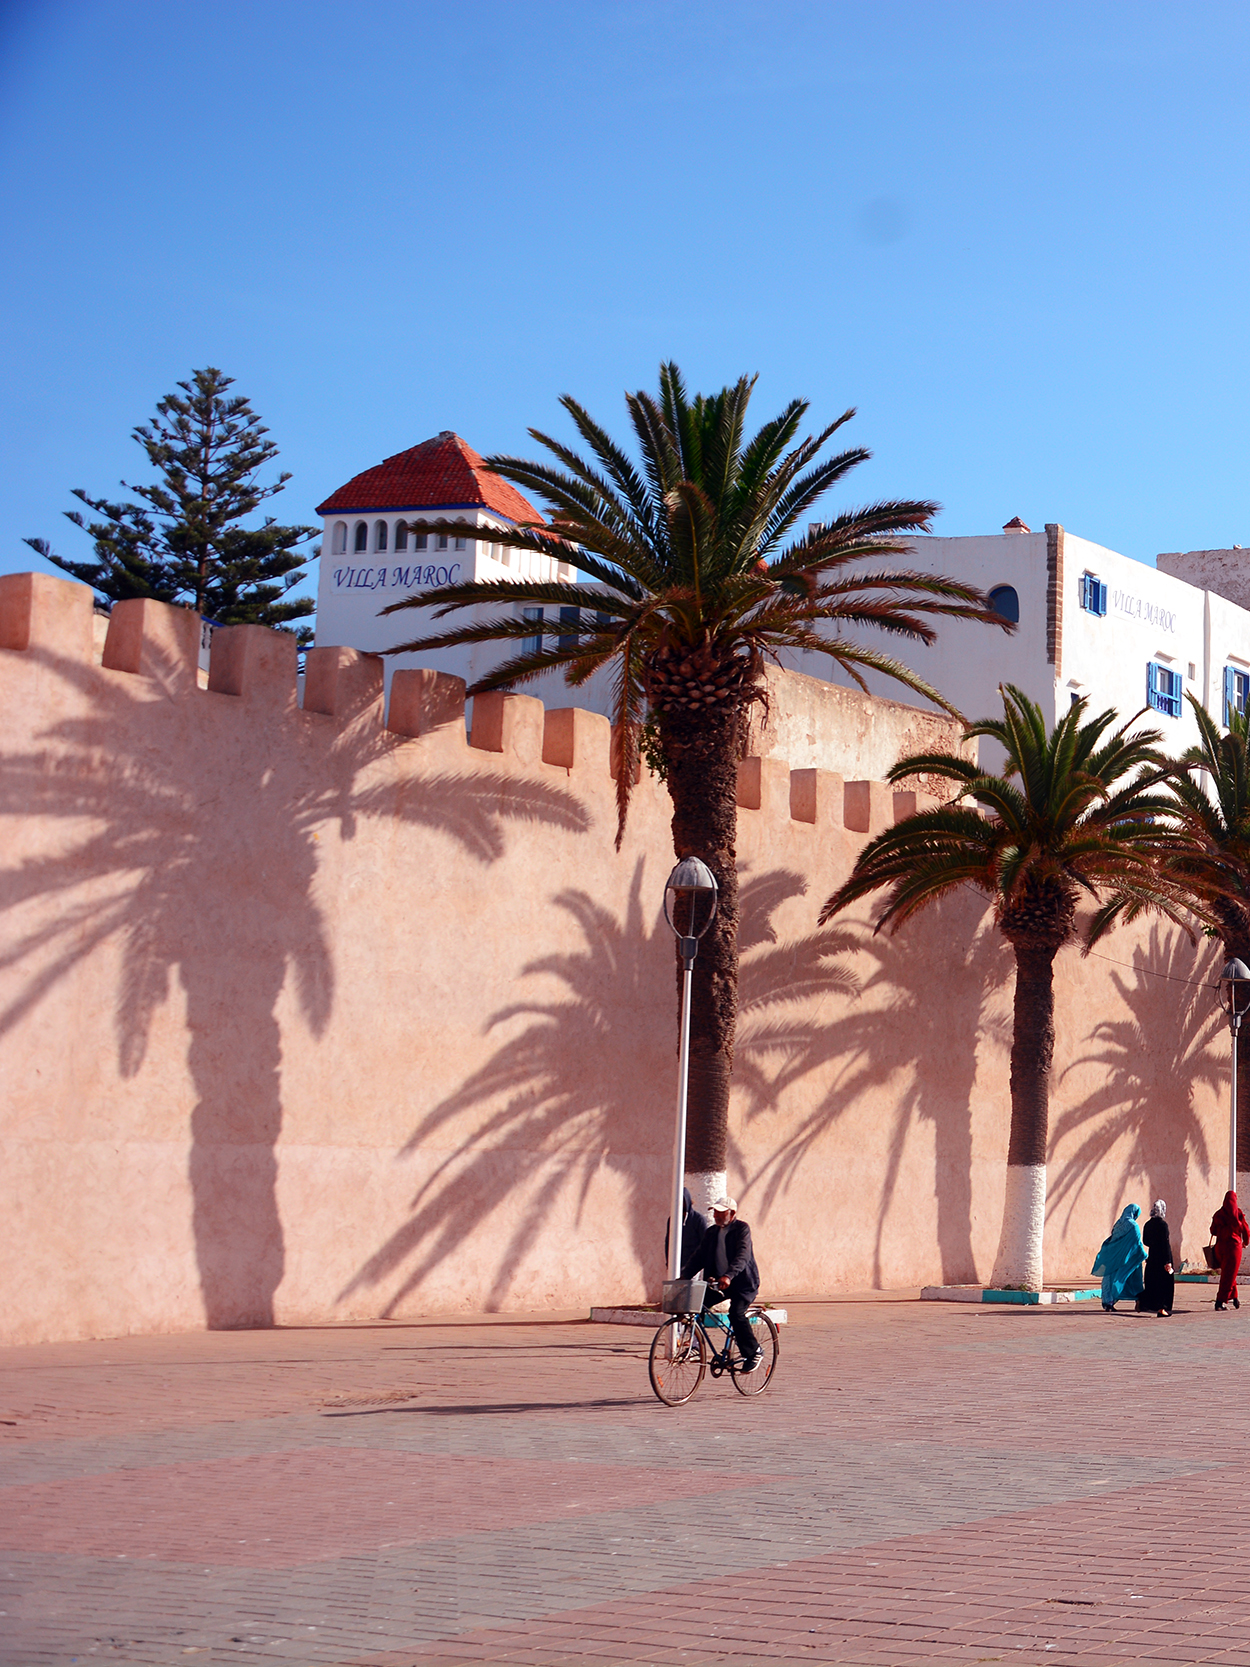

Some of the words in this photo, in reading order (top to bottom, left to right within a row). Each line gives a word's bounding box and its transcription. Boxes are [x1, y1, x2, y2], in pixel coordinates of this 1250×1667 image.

[333, 566, 387, 590] VILLA
[392, 563, 461, 588] MAROC
[1112, 589, 1142, 618] VILLA
[1144, 602, 1177, 633] MAROC
